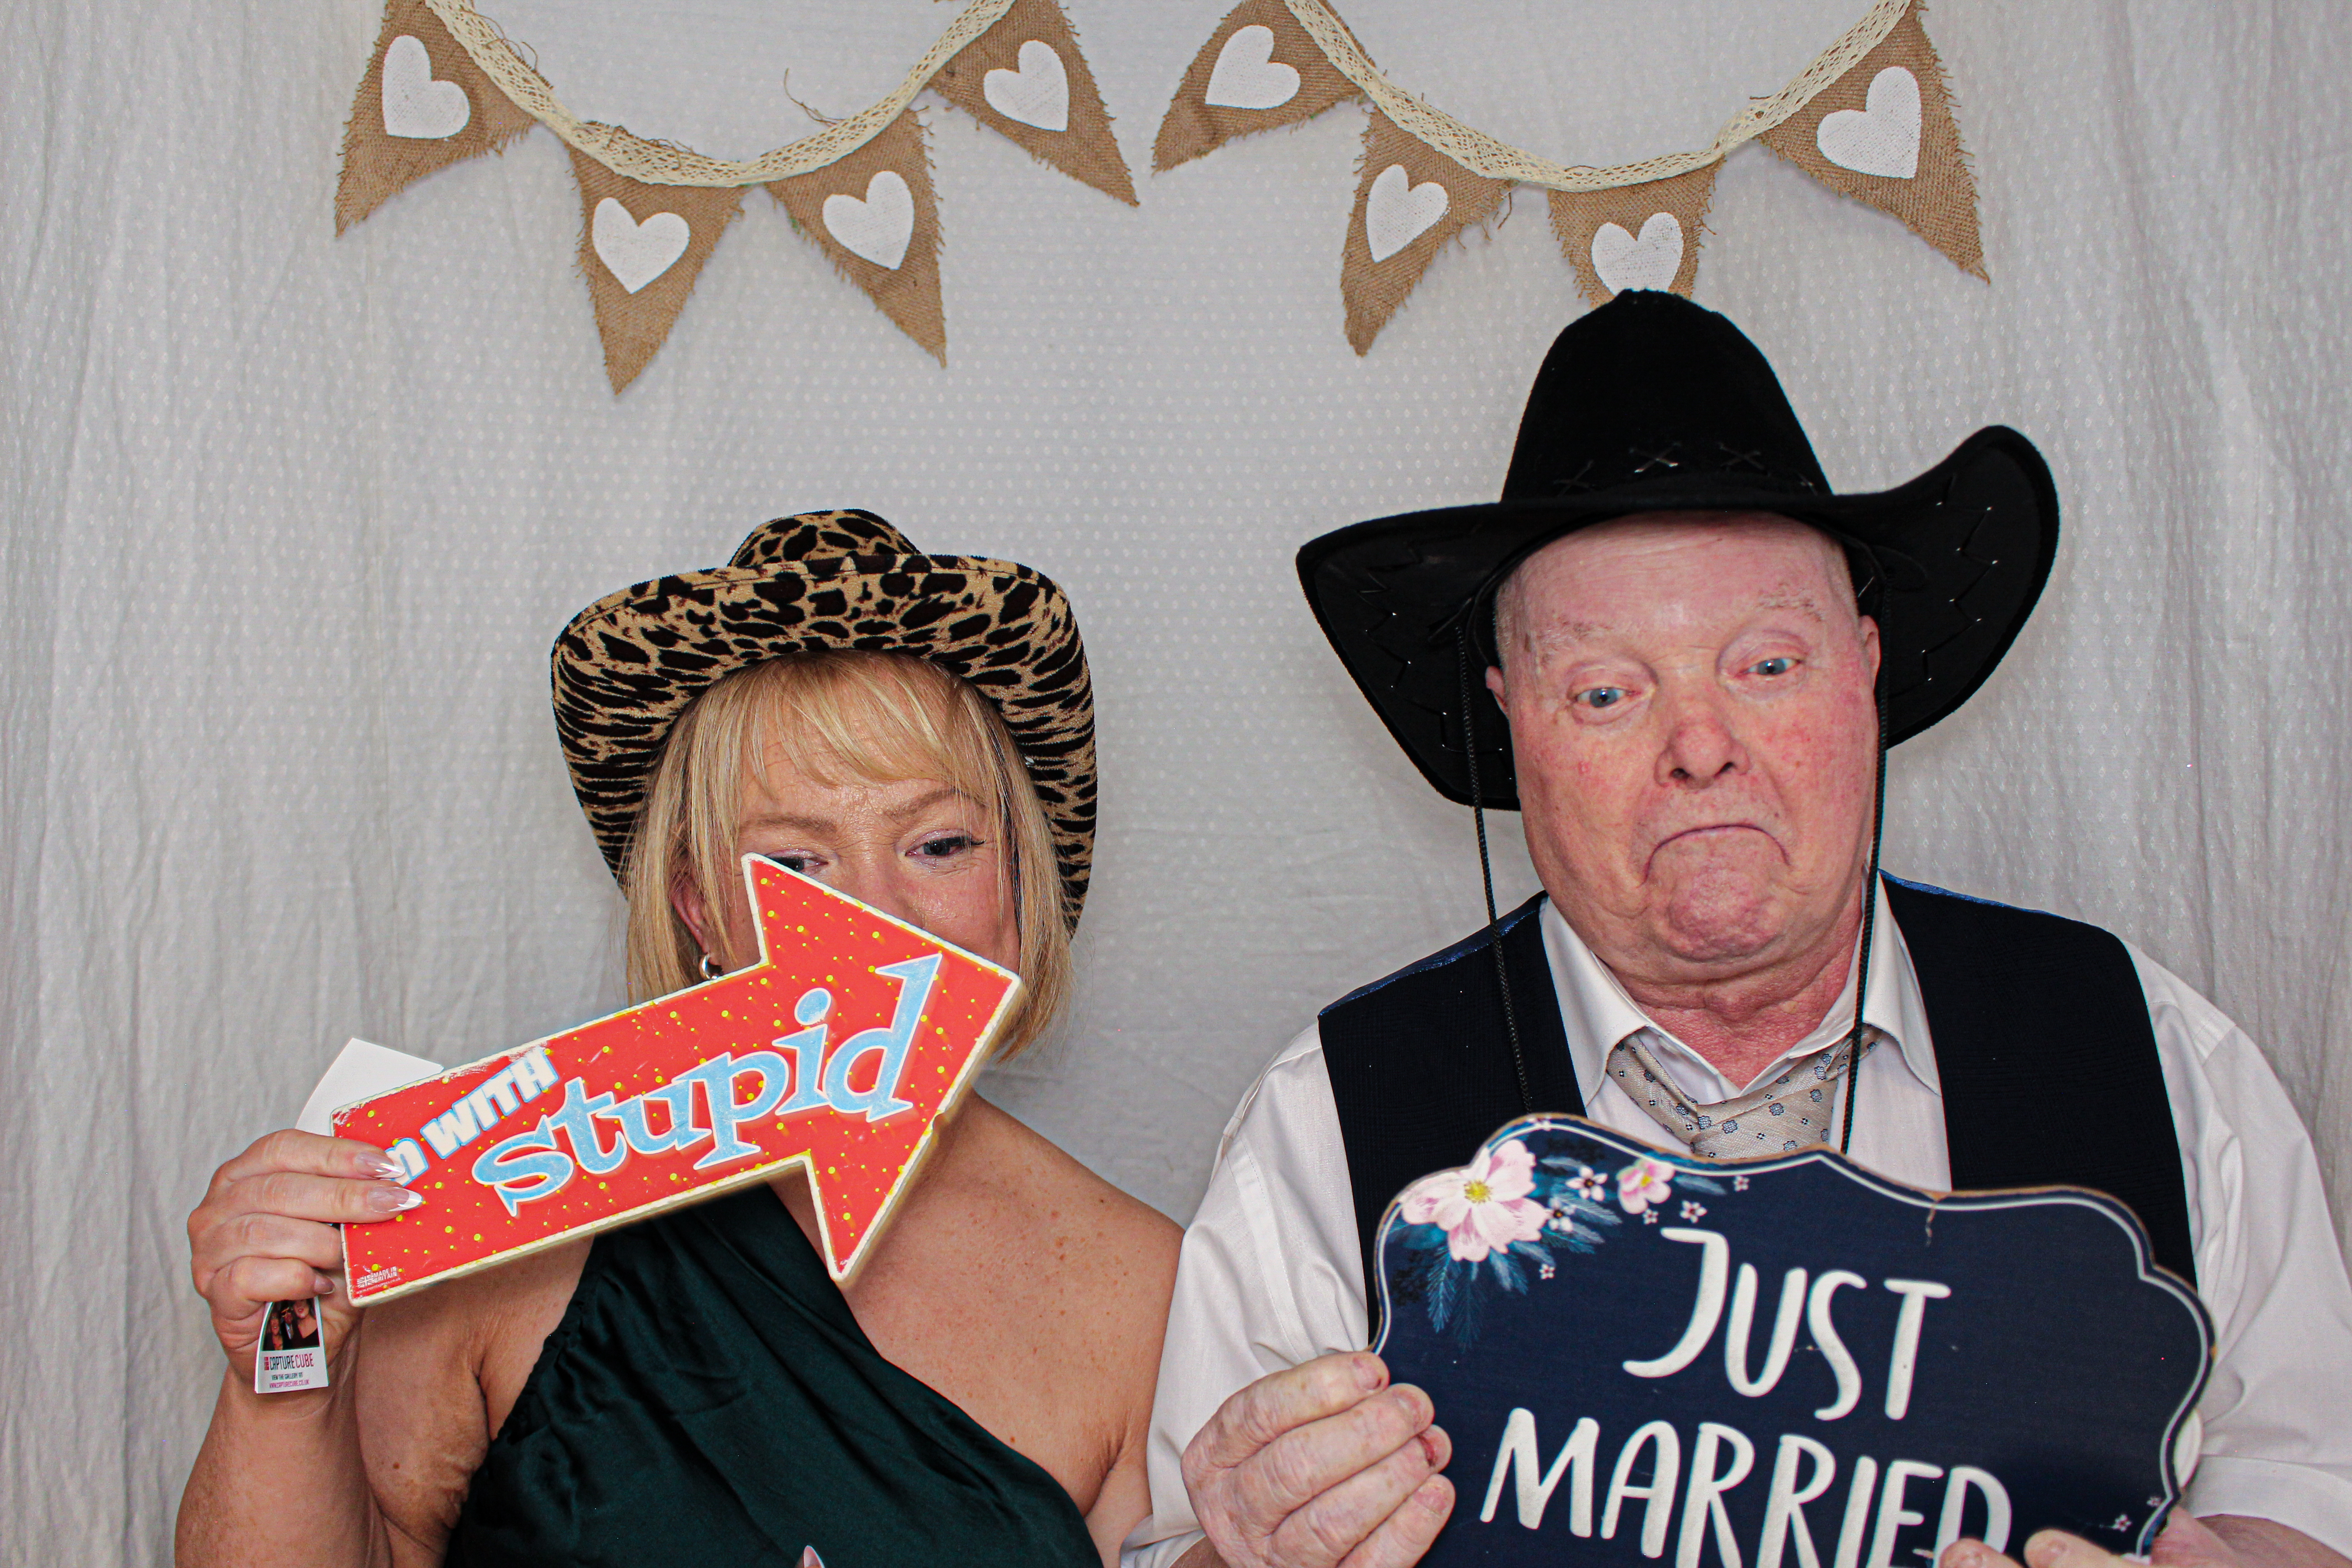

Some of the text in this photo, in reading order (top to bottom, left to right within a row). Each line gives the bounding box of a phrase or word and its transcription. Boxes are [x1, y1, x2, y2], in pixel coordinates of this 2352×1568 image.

[420, 1044, 559, 1159] WITH
[472, 953, 942, 1217] stupid
[373, 1269, 389, 1277] MADE
[374, 1272, 397, 1283] BRITAIN
[1623, 1228, 1951, 1420] JUST
[270, 1353, 314, 1370] CAPTURE CUBE
[1480, 1408, 2012, 1568] MARRIED
